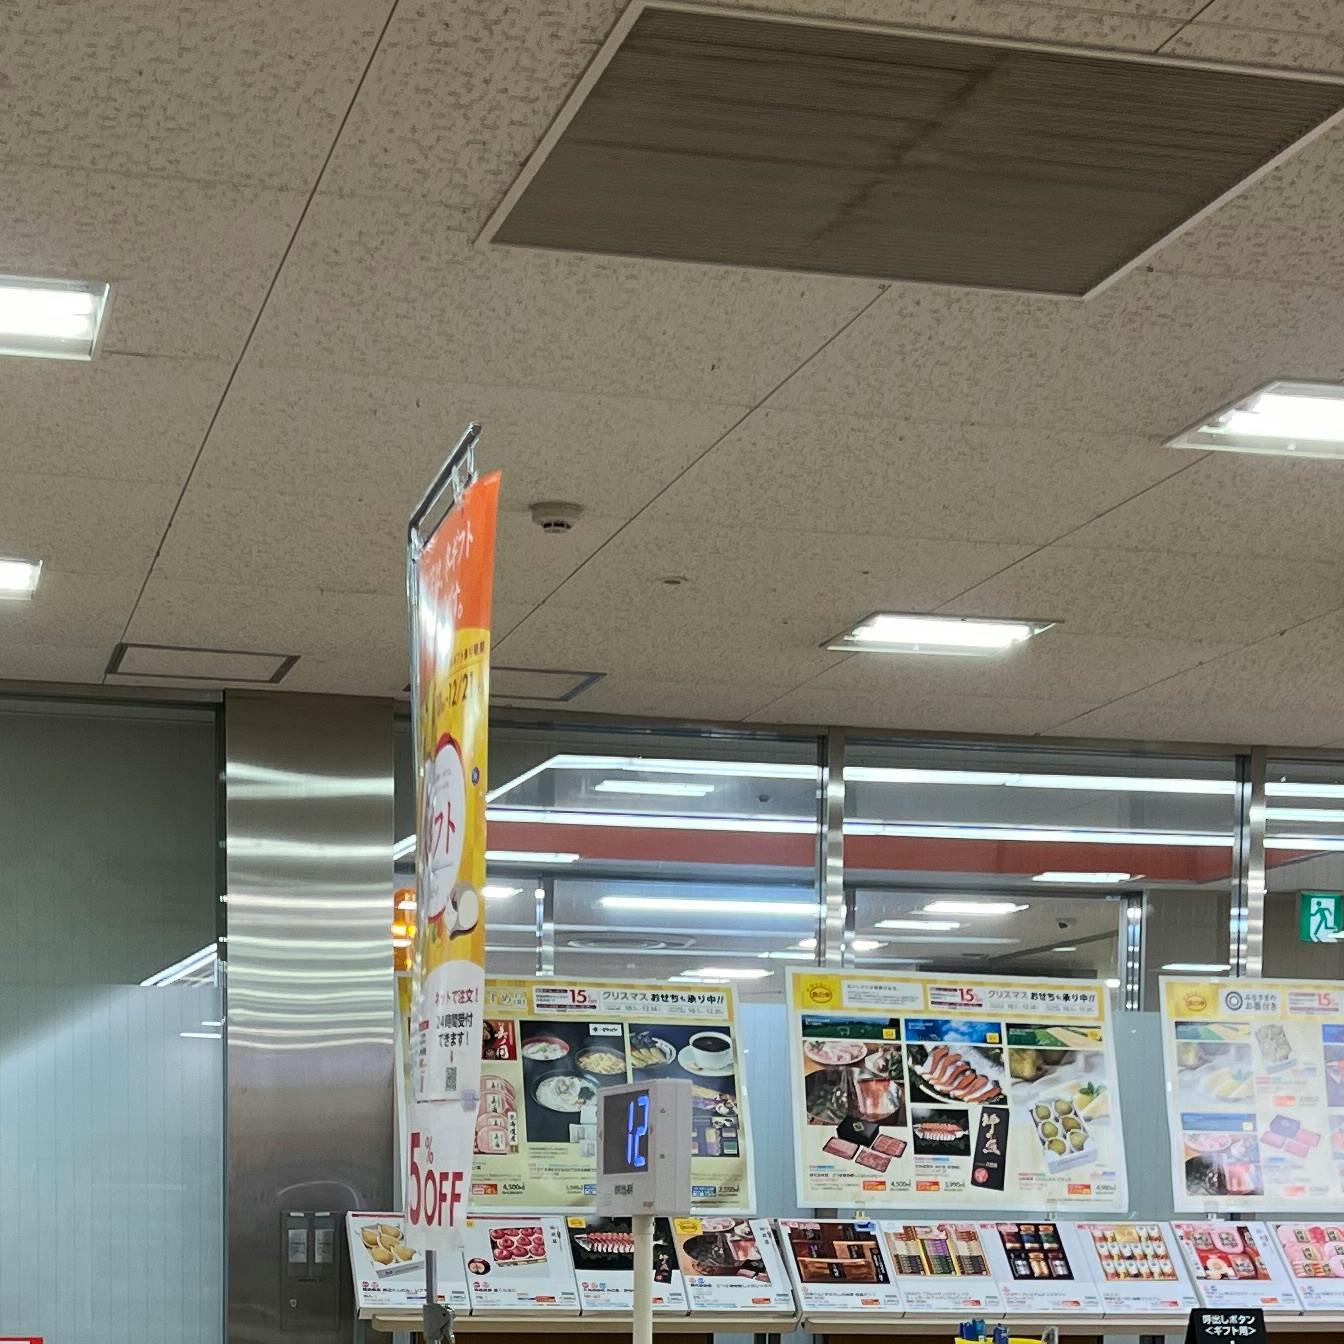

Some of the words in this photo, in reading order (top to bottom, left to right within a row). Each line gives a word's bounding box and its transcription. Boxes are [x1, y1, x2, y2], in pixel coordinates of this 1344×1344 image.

[602, 991, 648, 1002] クリスマス
[987, 990, 1028, 1000] クリスマス
[1201, 1314, 1256, 1325] 呼出しボタン
